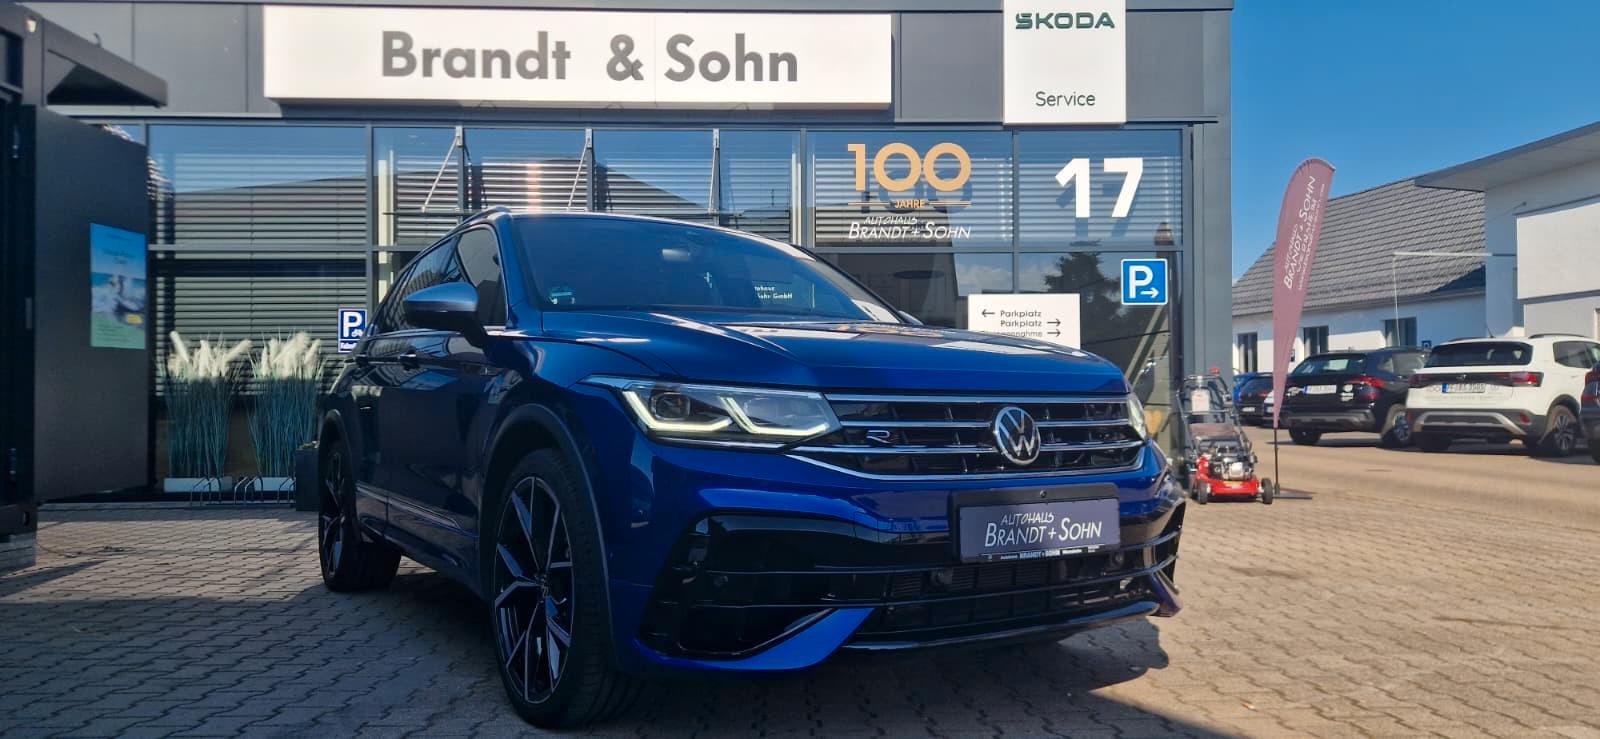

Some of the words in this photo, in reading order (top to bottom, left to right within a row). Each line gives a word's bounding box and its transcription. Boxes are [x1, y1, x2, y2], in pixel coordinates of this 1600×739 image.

[382, 30, 571, 80] Brandt
[606, 33, 644, 82] &
[664, 33, 798, 82] Sohn
[1035, 91, 1096, 107] Service
[847, 142, 972, 192] 100
[1055, 157, 1143, 218] 17
[1299, 175, 1316, 222] SOHN
[894, 199, 926, 209] JAHRE
[848, 221, 910, 239] BRANDT
[922, 221, 972, 239] SOHN
[863, 215, 918, 225] AUTOHAUS
[1128, 265, 1153, 299] P
[343, 311, 363, 338] P
[1000, 309, 1042, 320] Parkplatz
[1000, 319, 1042, 329] Parkplatz
[1000, 511, 1055, 526] AUTOHAUS
[984, 522, 1047, 547] BRANDT
[1047, 526, 1057, 540] +
[1058, 517, 1103, 542] SOHN
